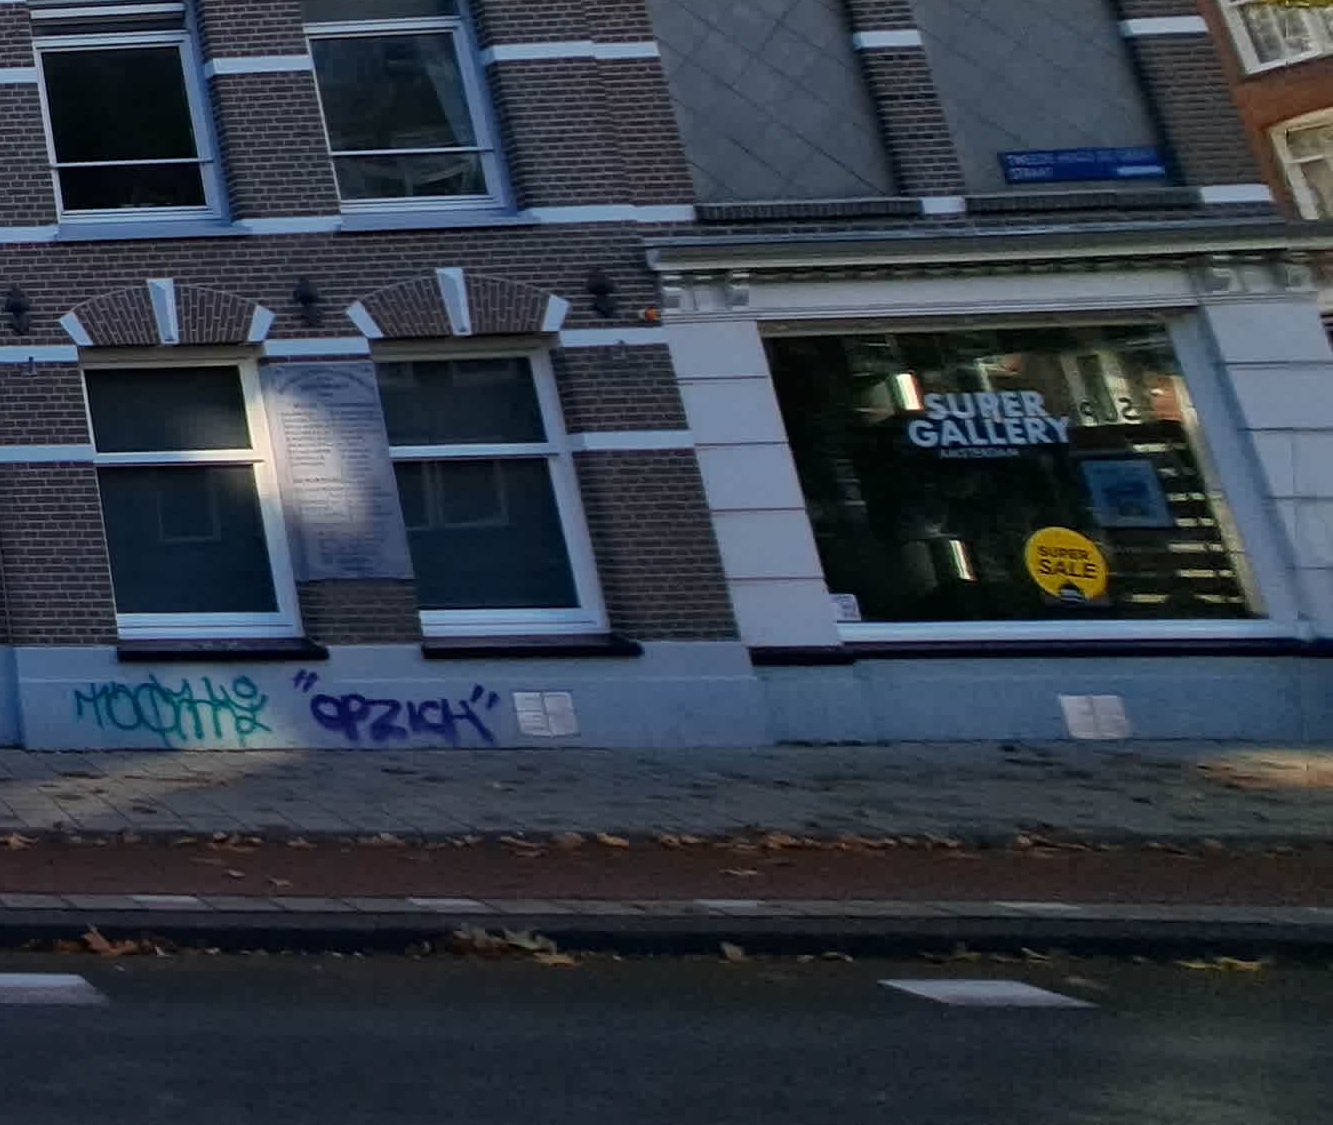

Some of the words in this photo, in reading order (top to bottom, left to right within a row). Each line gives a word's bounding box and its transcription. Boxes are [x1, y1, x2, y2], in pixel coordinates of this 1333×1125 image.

[924, 391, 1049, 421] SUPER
[908, 416, 1071, 448] GALLERY
[1037, 545, 1089, 560] SUPER
[1037, 559, 1097, 579] SALE
